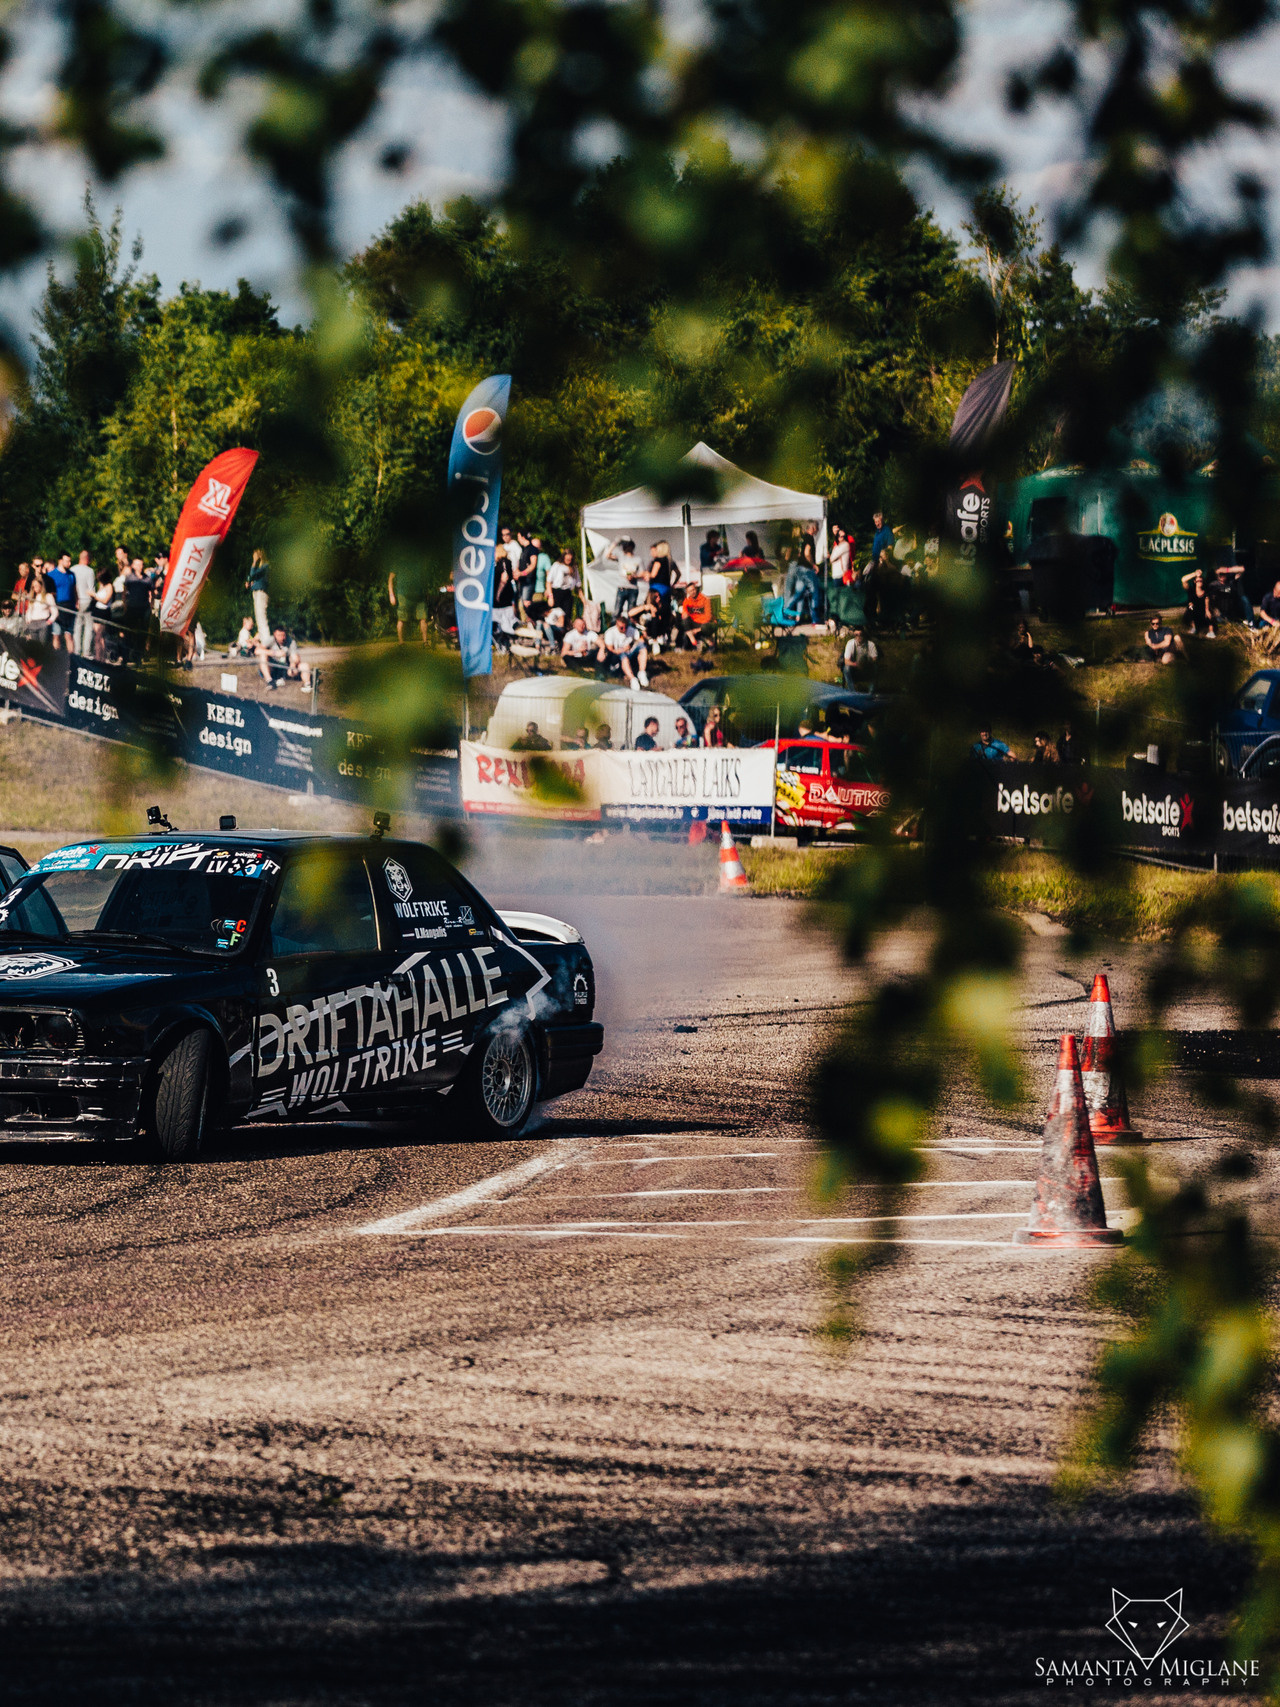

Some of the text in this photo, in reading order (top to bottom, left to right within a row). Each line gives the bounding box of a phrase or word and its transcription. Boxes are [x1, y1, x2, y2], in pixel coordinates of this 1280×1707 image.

[201, 478, 231, 515] XL
[164, 544, 204, 629] XL ENERGY
[68, 690, 120, 722] design
[206, 703, 245, 728] KEEL
[199, 727, 252, 757] design
[628, 758, 697, 798] LATGALES
[702, 758, 741, 798] LAIKS
[997, 782, 1074, 815] betsafe
[1122, 790, 1180, 826] betsafe
[1161, 825, 1180, 837] SPORTS
[393, 900, 449, 918] WOLFTRIKE
[229, 932, 241, 946] F
[236, 919, 246, 932] C
[266, 967, 280, 997] 3
[288, 1028, 437, 1110] WOLFTRIKE
